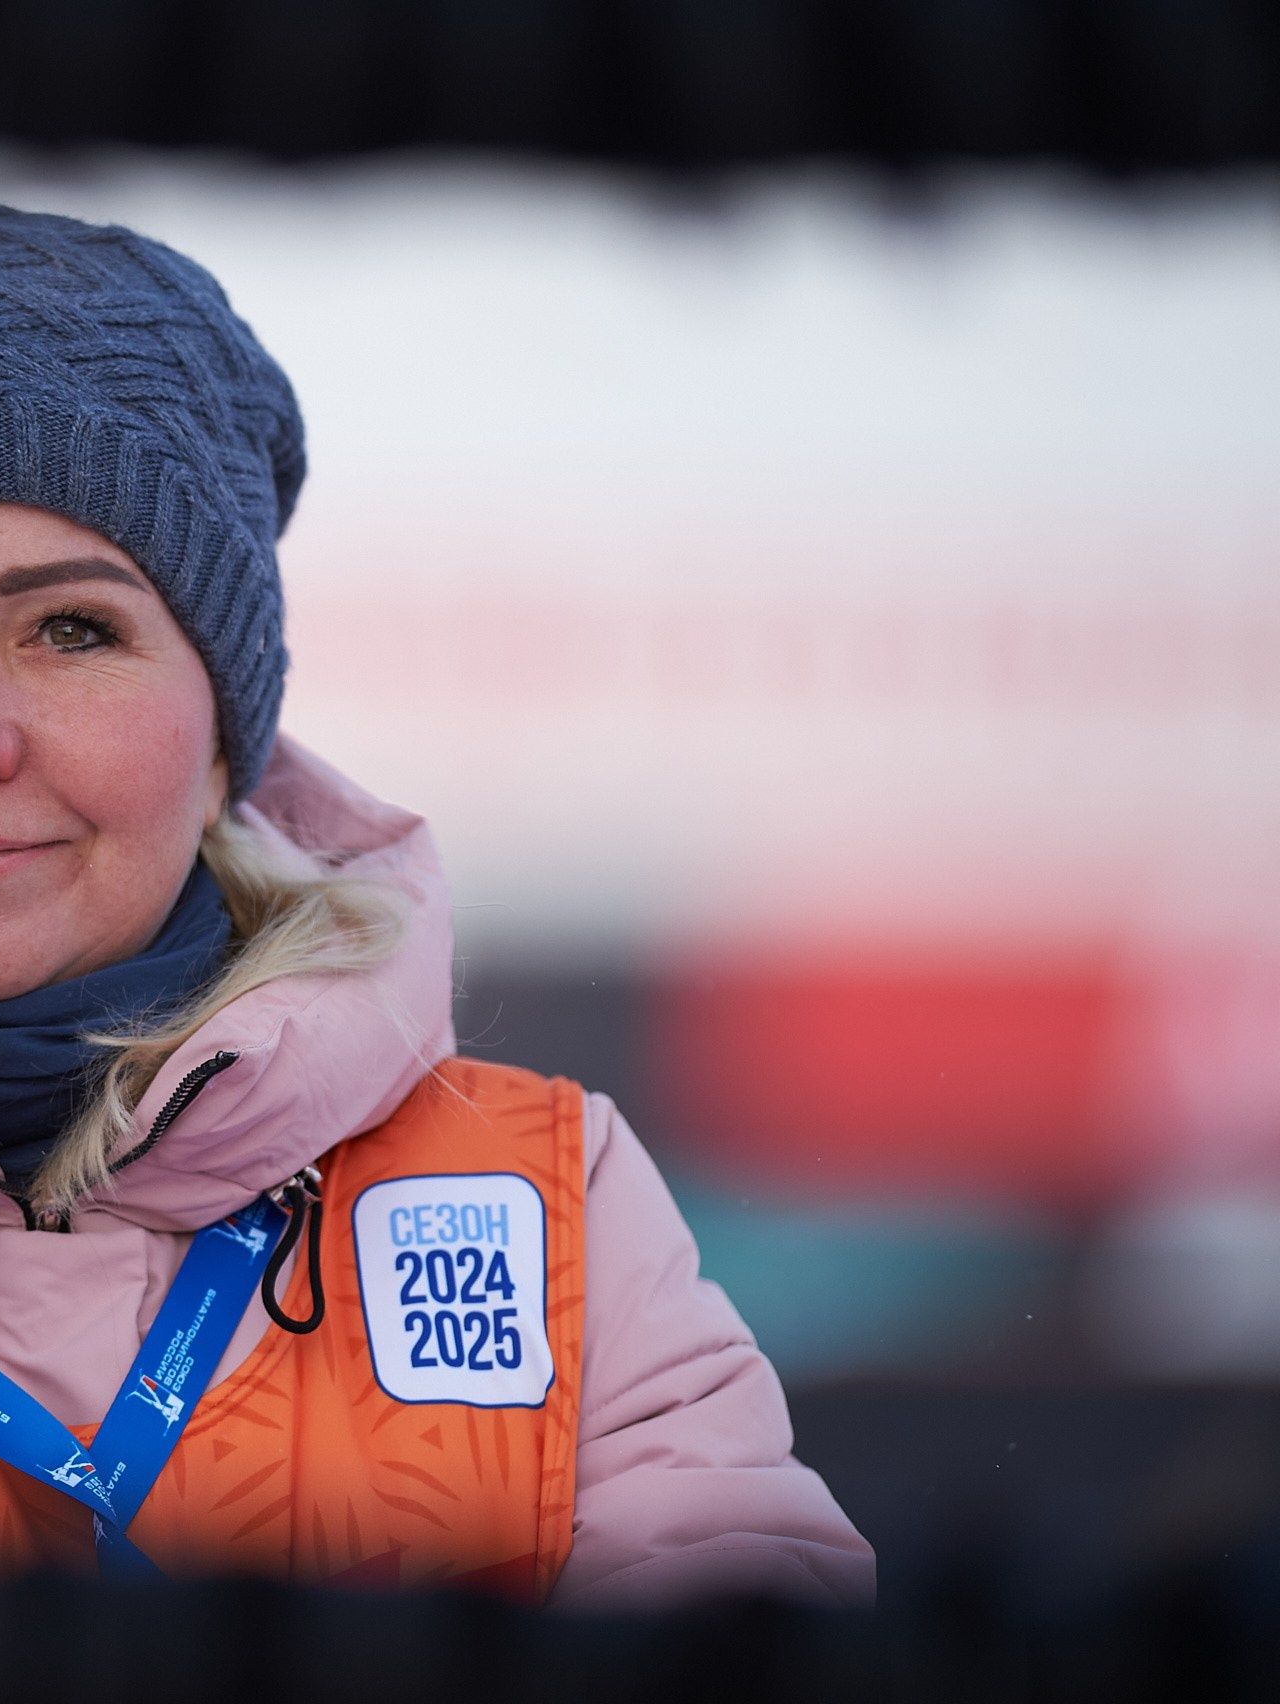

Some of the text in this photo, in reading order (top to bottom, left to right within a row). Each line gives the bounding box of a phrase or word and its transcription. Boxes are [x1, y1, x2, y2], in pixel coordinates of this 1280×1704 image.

[389, 1203, 510, 1247] СЕЗОН
[395, 1247, 516, 1306] 2024
[154, 1329, 185, 1381] РОССИИ
[163, 1288, 217, 1386] БИАТЛОНИСТОВ
[404, 1308, 522, 1371] 2025
[172, 1356, 195, 1393] СОЮЗ
